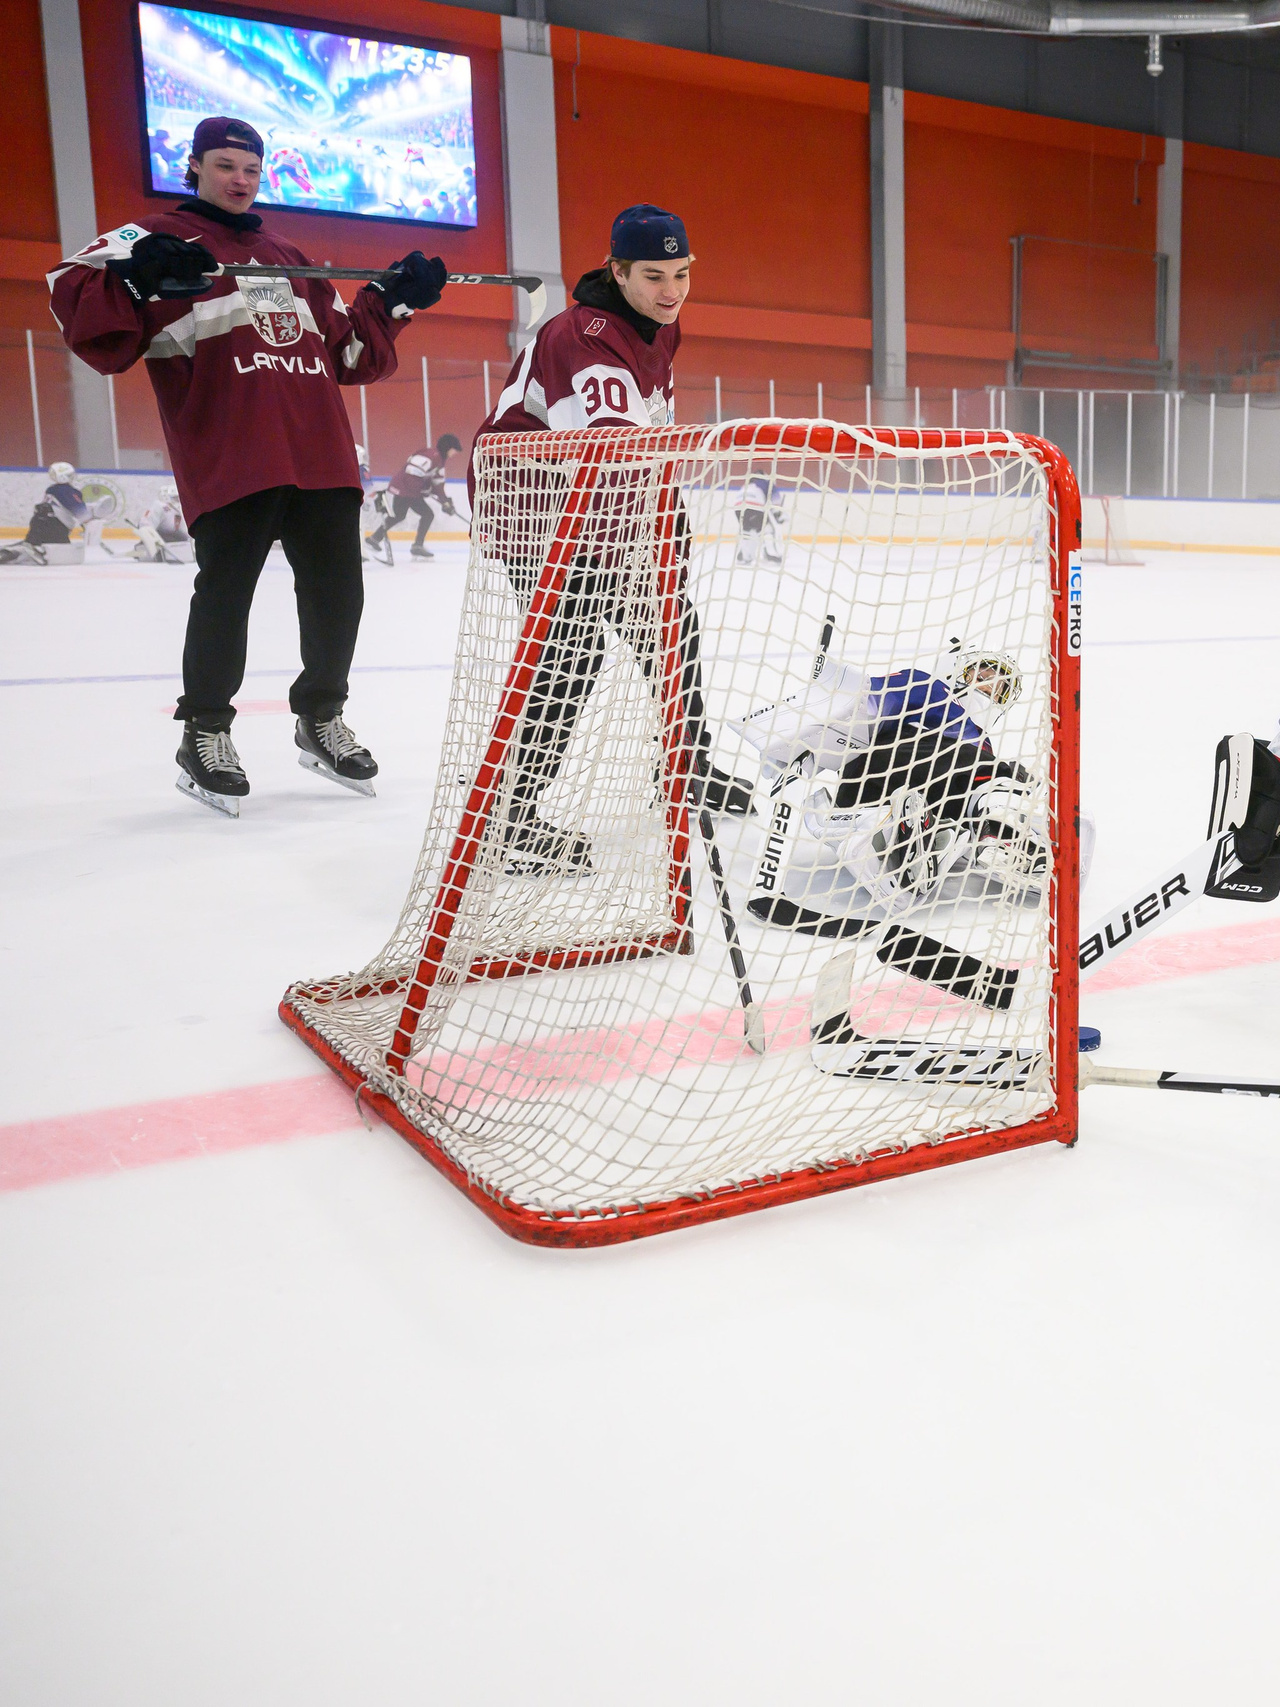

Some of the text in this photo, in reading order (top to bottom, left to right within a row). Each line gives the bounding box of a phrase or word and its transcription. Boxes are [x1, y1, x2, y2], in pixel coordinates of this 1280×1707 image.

[346, 37, 469, 77] 11:23:5
[124, 278, 142, 300] CCM
[446, 274, 483, 285] CC
[580, 376, 629, 417] 30
[1069, 565, 1082, 650] ICEPRO
[742, 695, 797, 722] BAUR
[1220, 882, 1264, 894] CCM
[1079, 872, 1192, 970] AUER
[847, 1049, 1045, 1077] CCM
